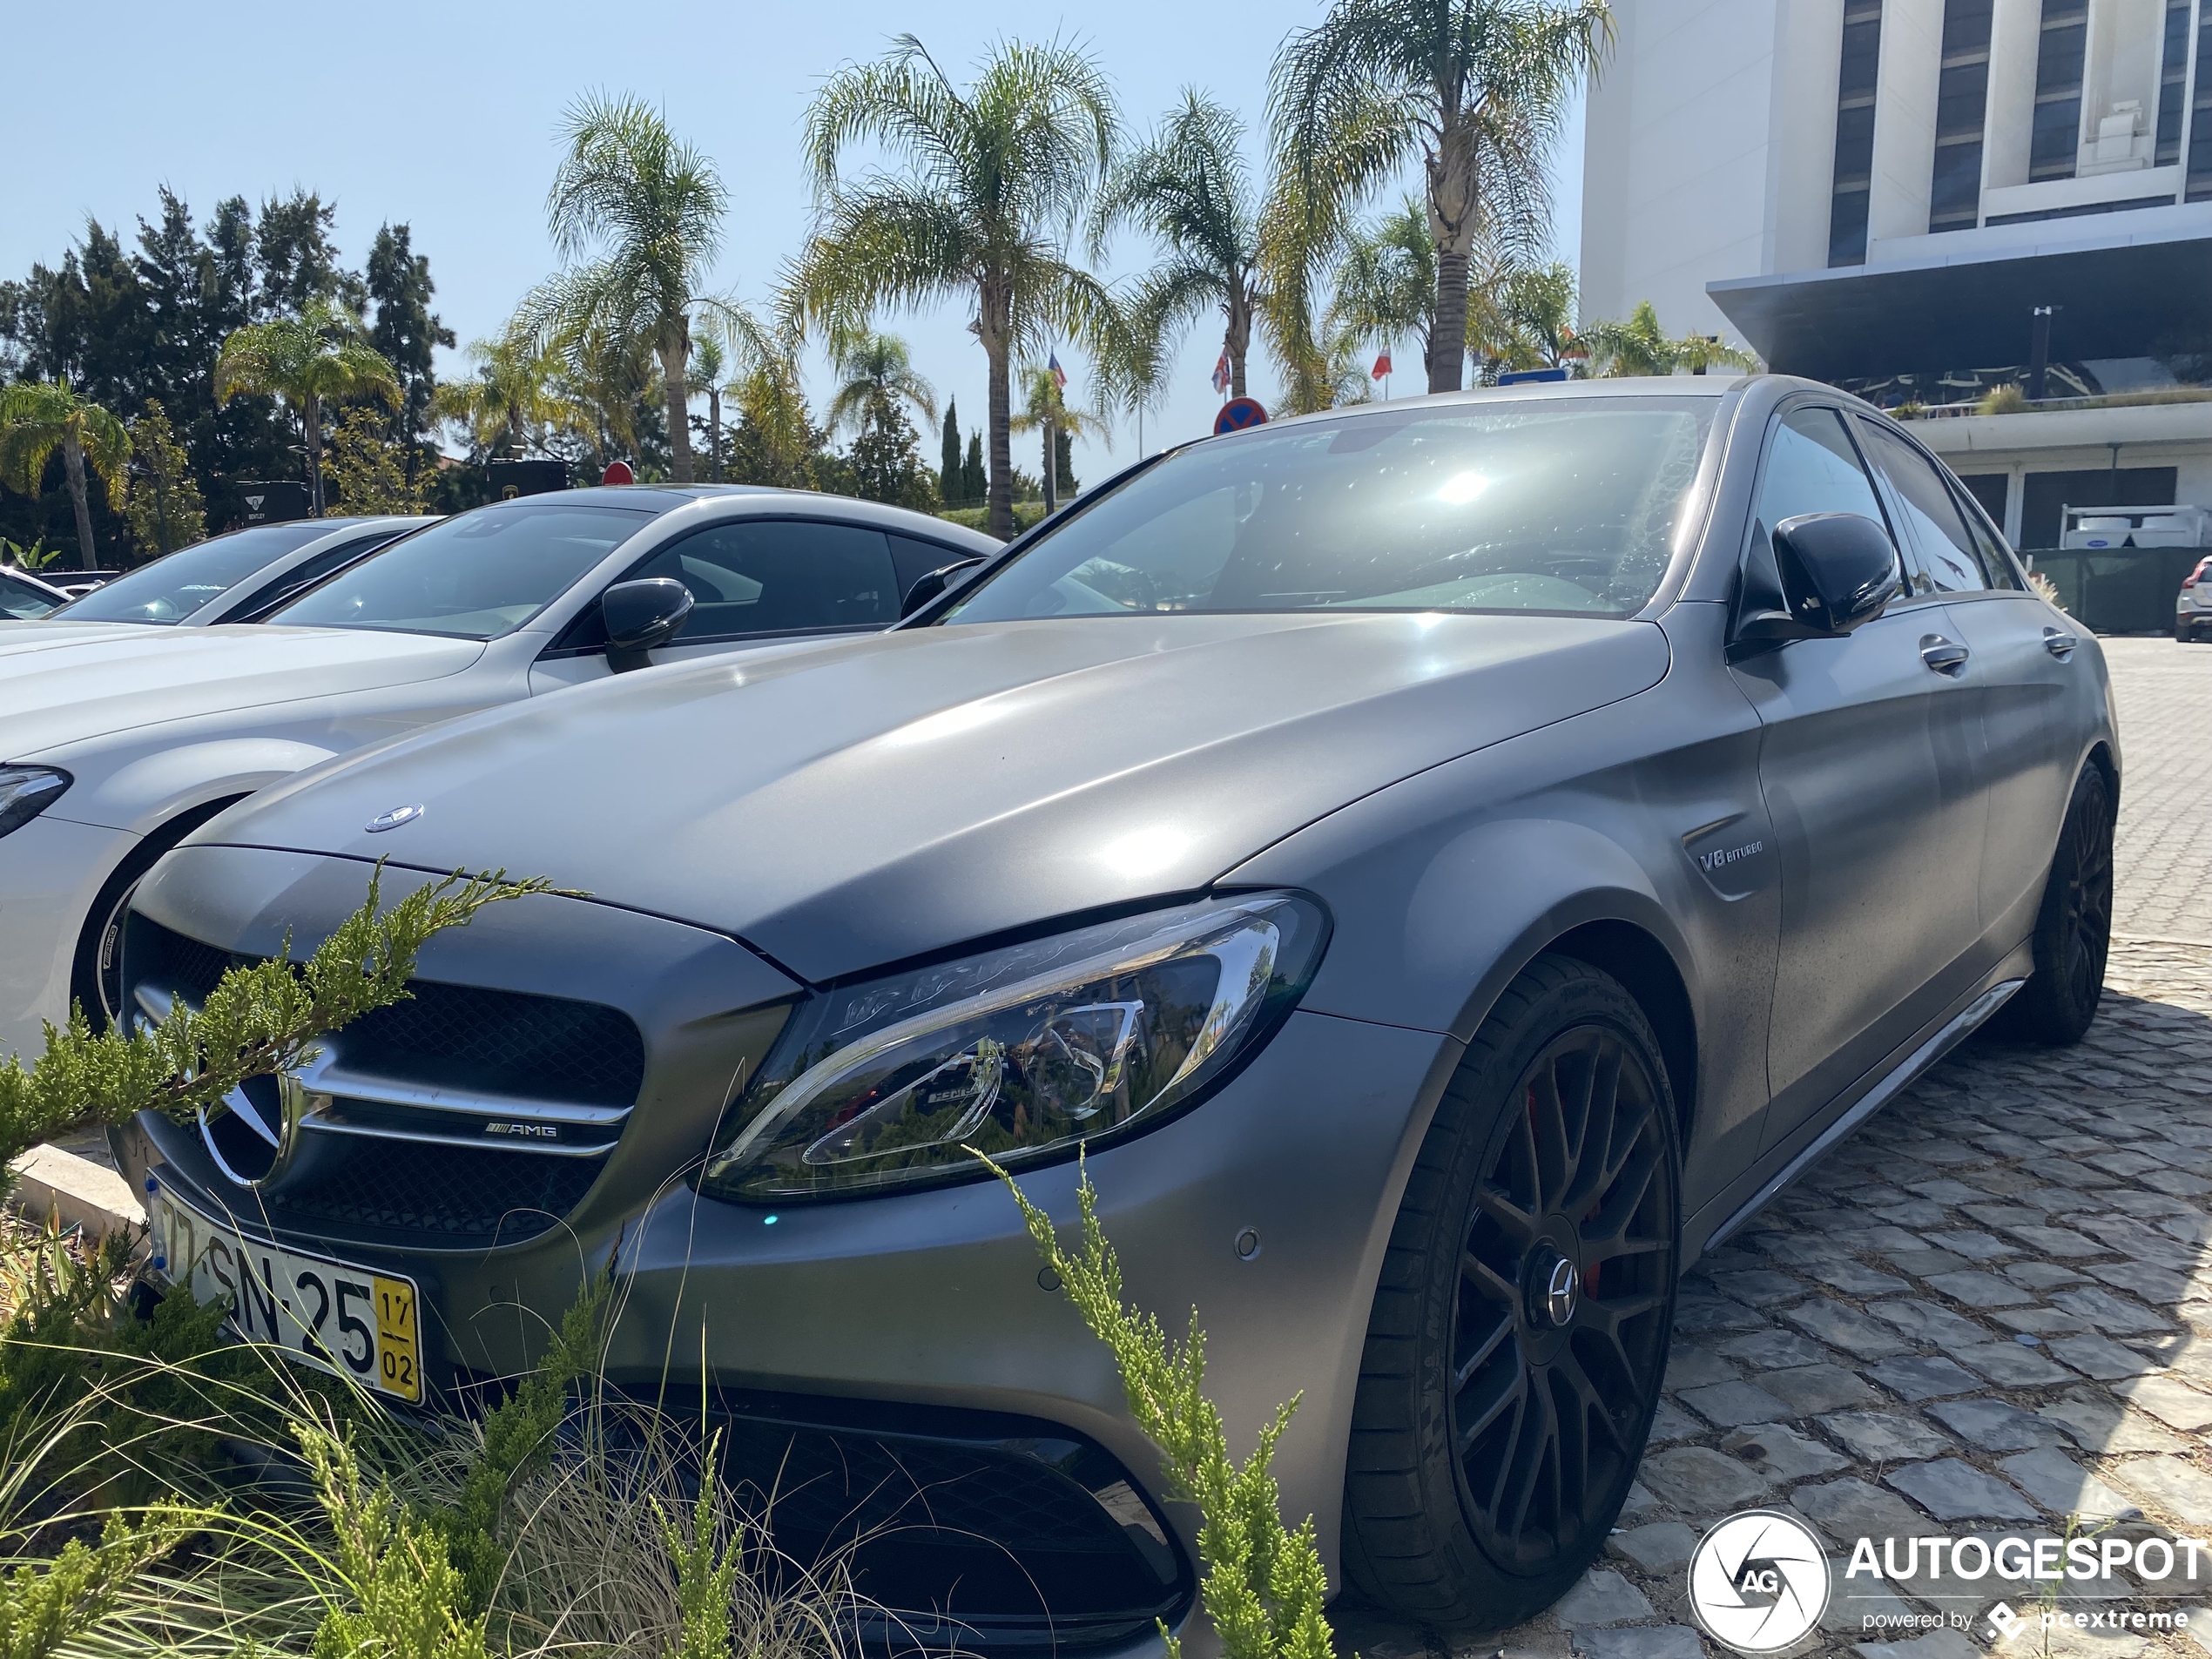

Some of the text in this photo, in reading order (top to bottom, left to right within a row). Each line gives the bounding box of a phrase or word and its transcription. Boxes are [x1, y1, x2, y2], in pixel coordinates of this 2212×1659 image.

[1700, 840, 1763, 872] V8 BITURBO
[106, 927, 117, 954] AMG
[508, 1124, 557, 1137] AMG
[382, 1292, 408, 1325] 17
[383, 1351, 413, 1385] 02
